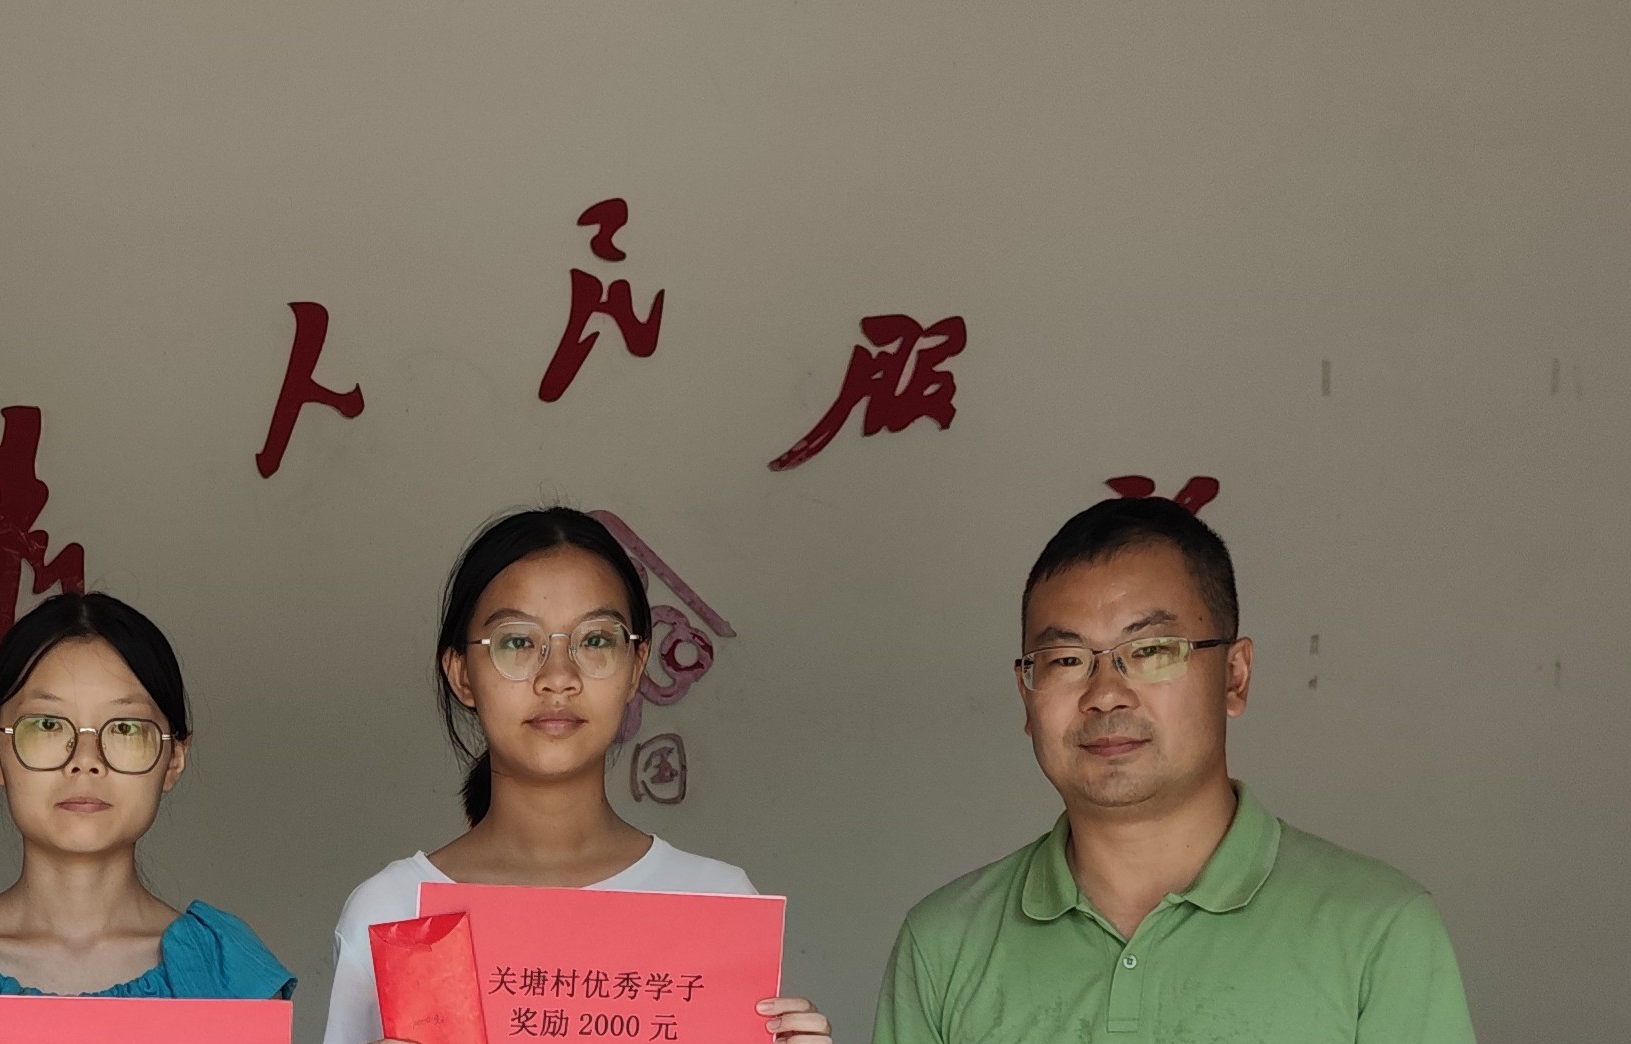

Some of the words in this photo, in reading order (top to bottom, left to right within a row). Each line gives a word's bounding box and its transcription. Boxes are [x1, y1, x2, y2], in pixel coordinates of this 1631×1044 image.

[488, 966, 706, 1003] 关塘村优秀学子
[508, 1007, 570, 1038] 奖励
[578, 1012, 641, 1038] 2000
[649, 1013, 679, 1042] 元
